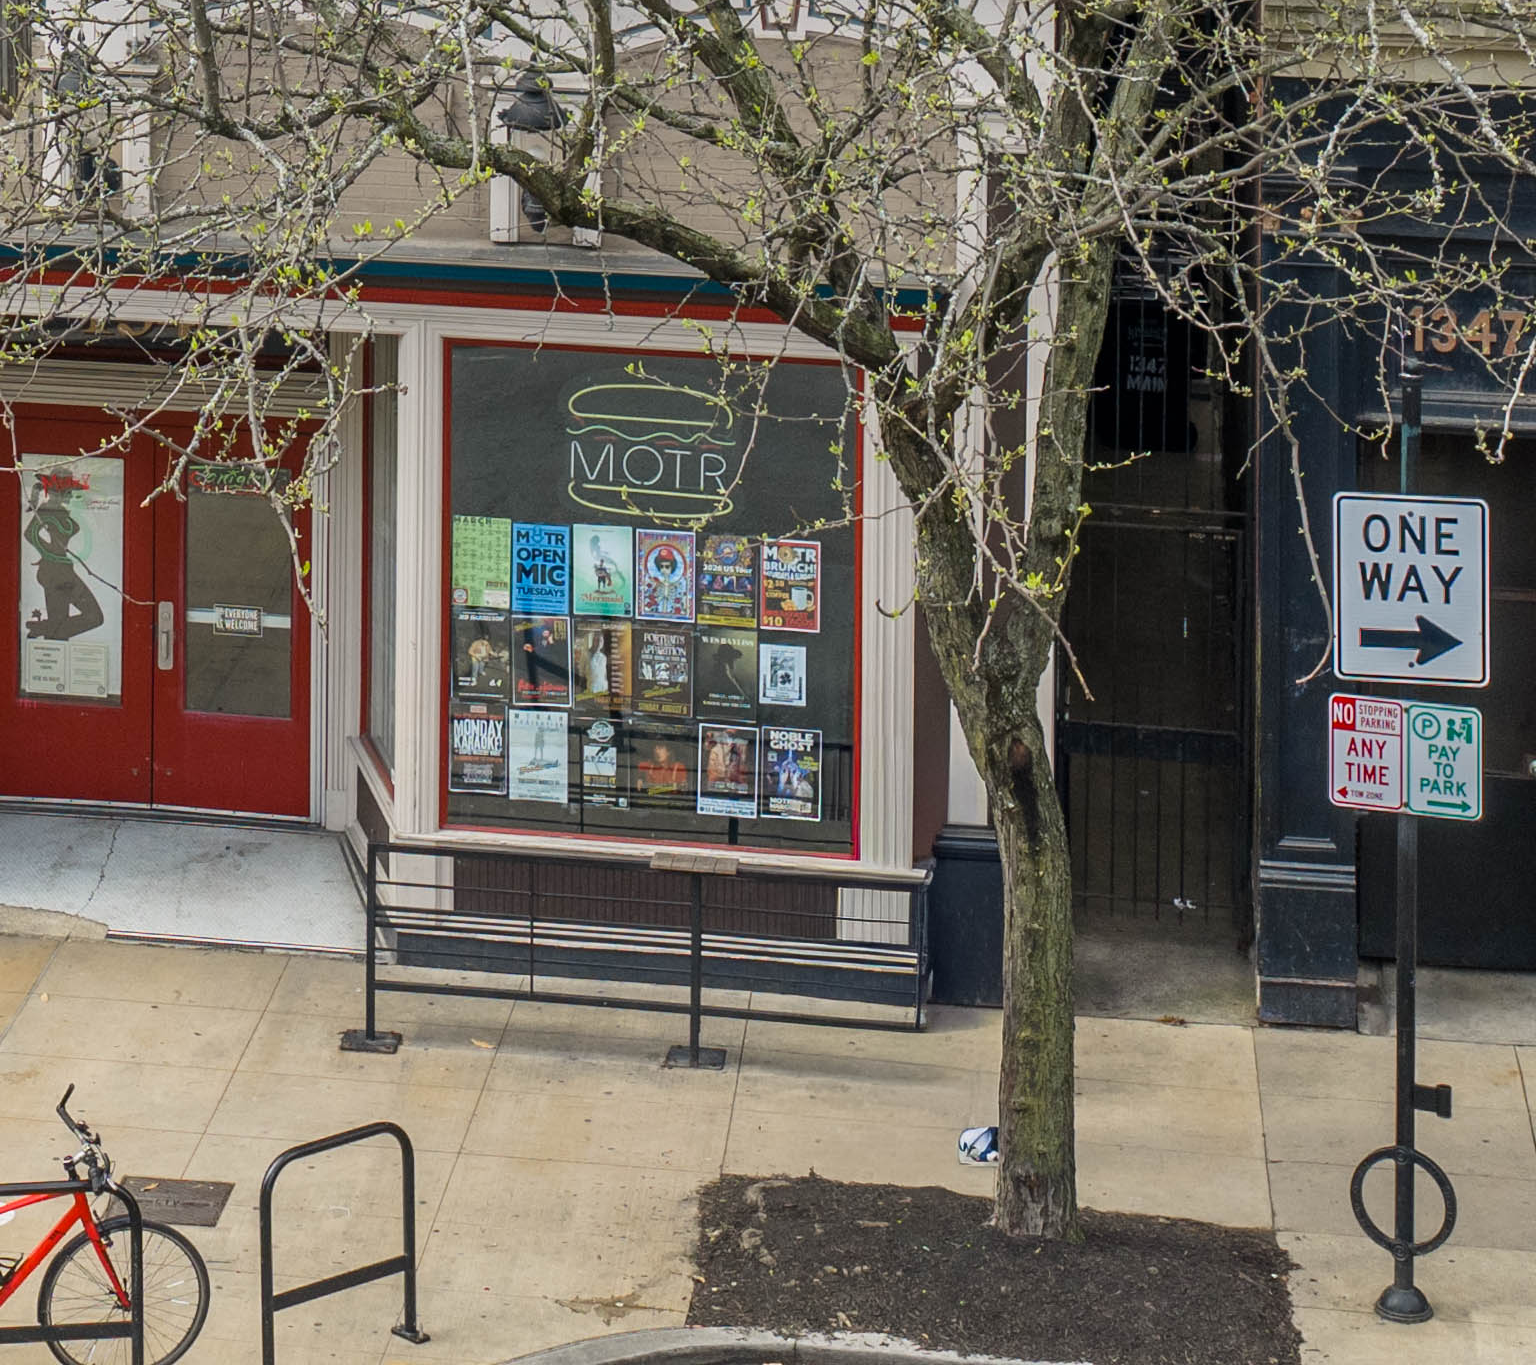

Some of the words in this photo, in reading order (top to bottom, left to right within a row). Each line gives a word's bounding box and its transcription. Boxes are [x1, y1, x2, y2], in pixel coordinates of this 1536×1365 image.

[1408, 305, 1527, 356] 1347
[570, 440, 727, 494] MOTR
[454, 516, 491, 525] MARCH
[1362, 513, 1460, 556] ONE
[516, 547, 566, 563] OPEN
[516, 562, 566, 586] MIC
[764, 560, 816, 573] BRUNCH!
[1358, 561, 1464, 605] WAY
[516, 586, 566, 597] TUESDAYS
[225, 608, 258, 620] EVERYONE
[763, 615, 783, 626] $10
[225, 619, 258, 630] WELCOME
[1333, 701, 1354, 725] NO
[1358, 704, 1399, 719] STOPPING
[453, 718, 503, 738] MONDAY
[1360, 717, 1396, 731] PARKING
[1421, 718, 1434, 734] P
[769, 730, 814, 741] NOBLE
[769, 739, 814, 751] GHOST
[1347, 736, 1387, 760] ANY
[1428, 744, 1460, 762] PAY
[1345, 762, 1389, 786] TIME
[1433, 762, 1454, 779] TO
[1350, 789, 1364, 798] TOW
[1366, 790, 1384, 800] ZONE
[1420, 777, 1467, 797] PARK
